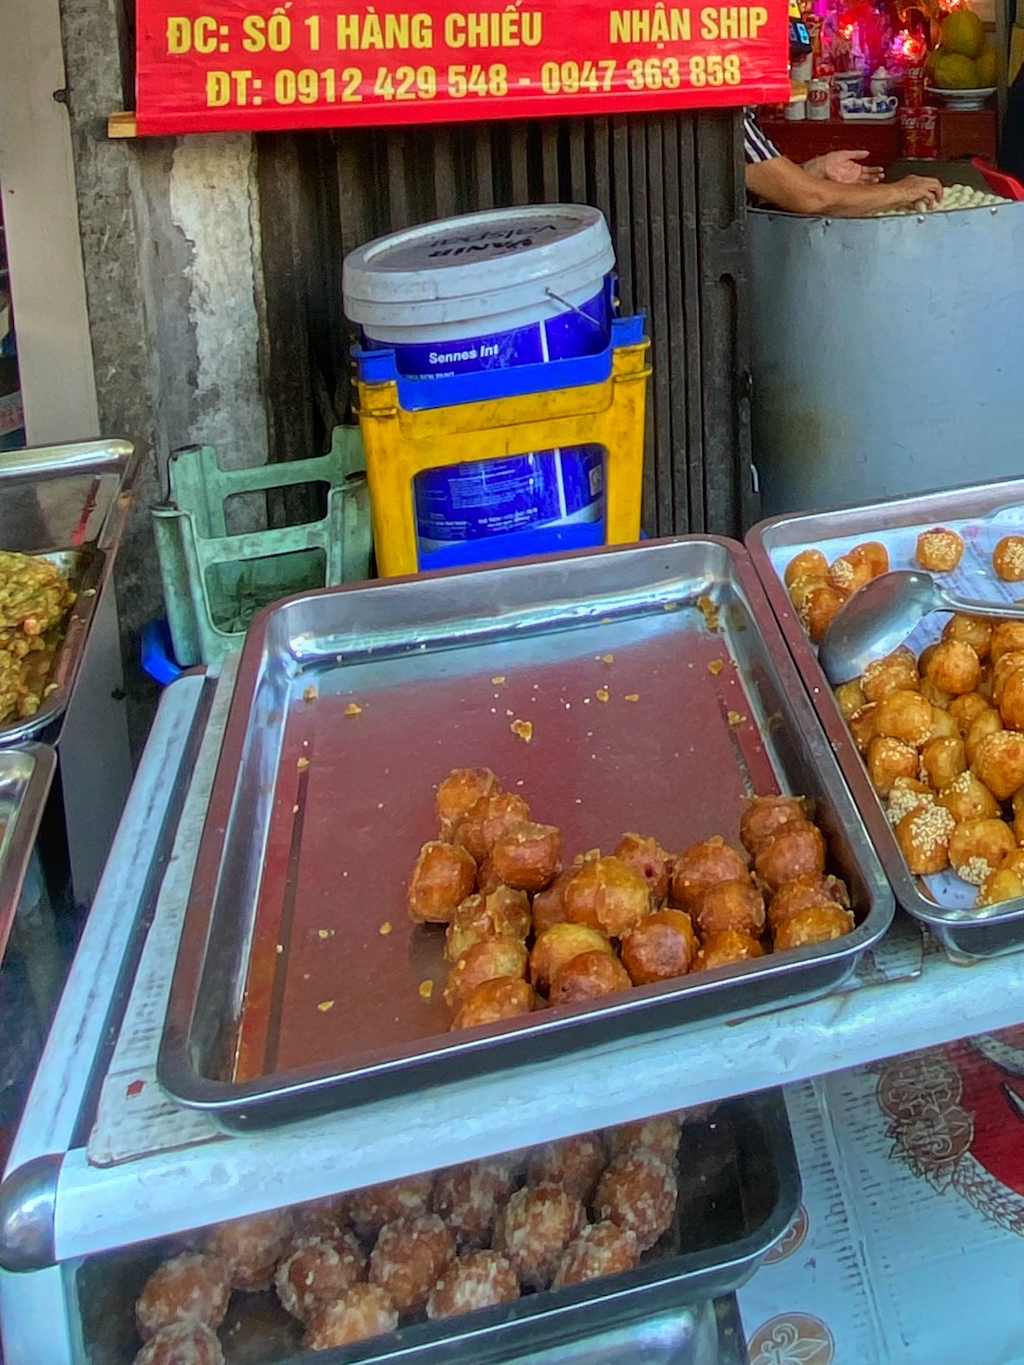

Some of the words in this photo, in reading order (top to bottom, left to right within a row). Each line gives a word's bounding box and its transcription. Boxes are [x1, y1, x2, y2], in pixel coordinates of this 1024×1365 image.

[166, 16, 229, 54] ĐC:
[243, 2, 292, 52] SỐ
[304, 15, 319, 50] 1
[337, 6, 433, 50] HÀNG
[444, 0, 542, 48] CHIẾU
[610, 1, 690, 49] NHẬN
[701, 7, 767, 39] SHIP
[206, 71, 261, 106] ĐT:
[275, 68, 362, 103] 0912
[374, 66, 436, 99] 429
[448, 64, 508, 97] 548
[541, 61, 616, 94] 0947
[624, 57, 680, 89] 363
[689, 53, 741, 86] 858
[429, 349, 478, 364] Sennes
[480, 344, 499, 357] Int
